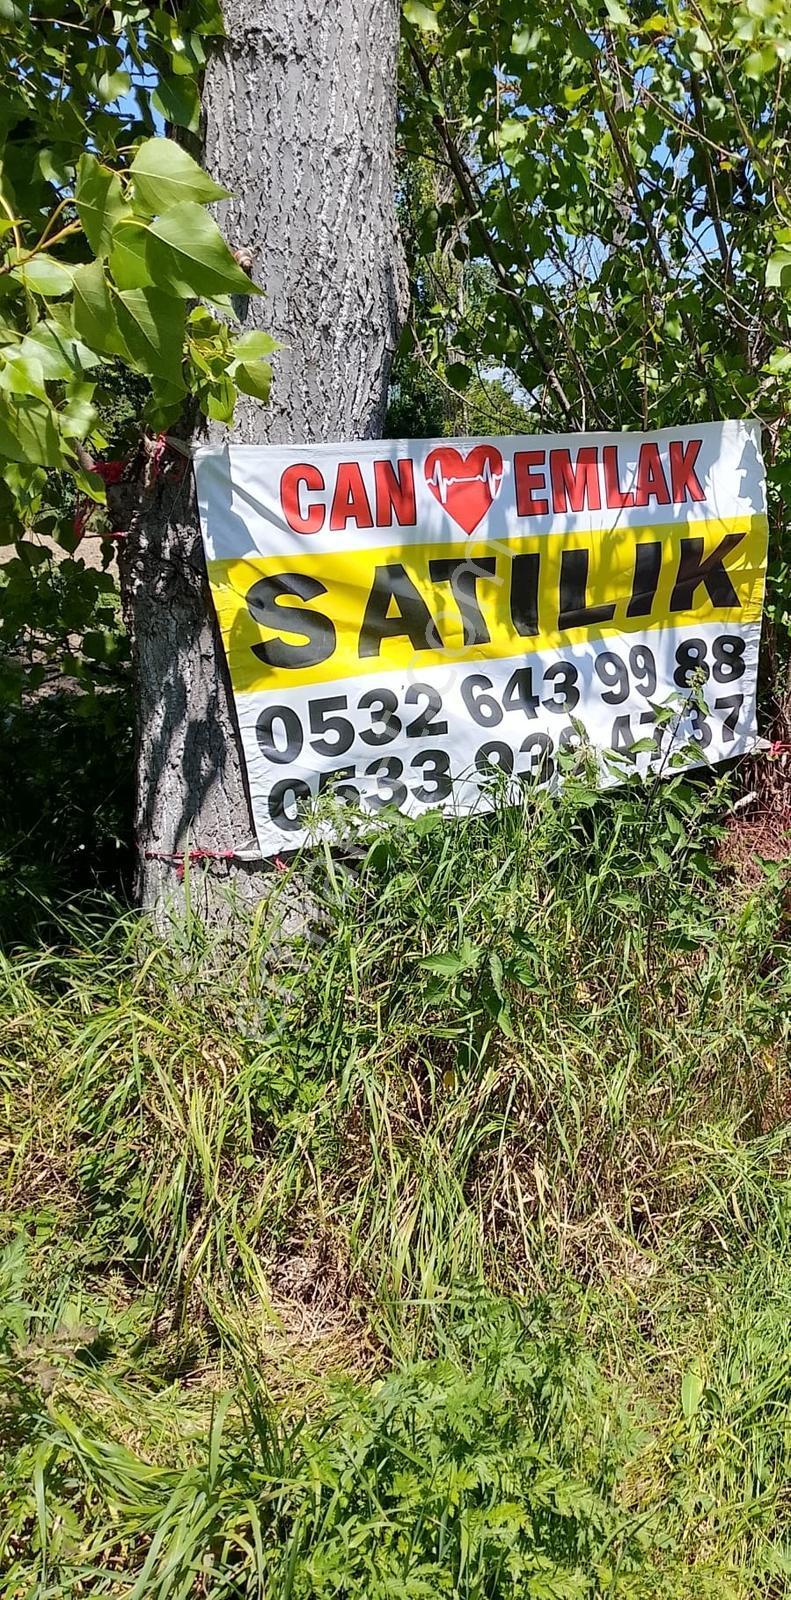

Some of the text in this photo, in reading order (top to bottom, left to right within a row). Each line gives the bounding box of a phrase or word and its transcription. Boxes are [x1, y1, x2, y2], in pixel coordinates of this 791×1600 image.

[280, 439, 706, 534] CAN EMLAK
[245, 532, 747, 669] SATILIK
[256, 634, 746, 764] 0532 643 99 88
